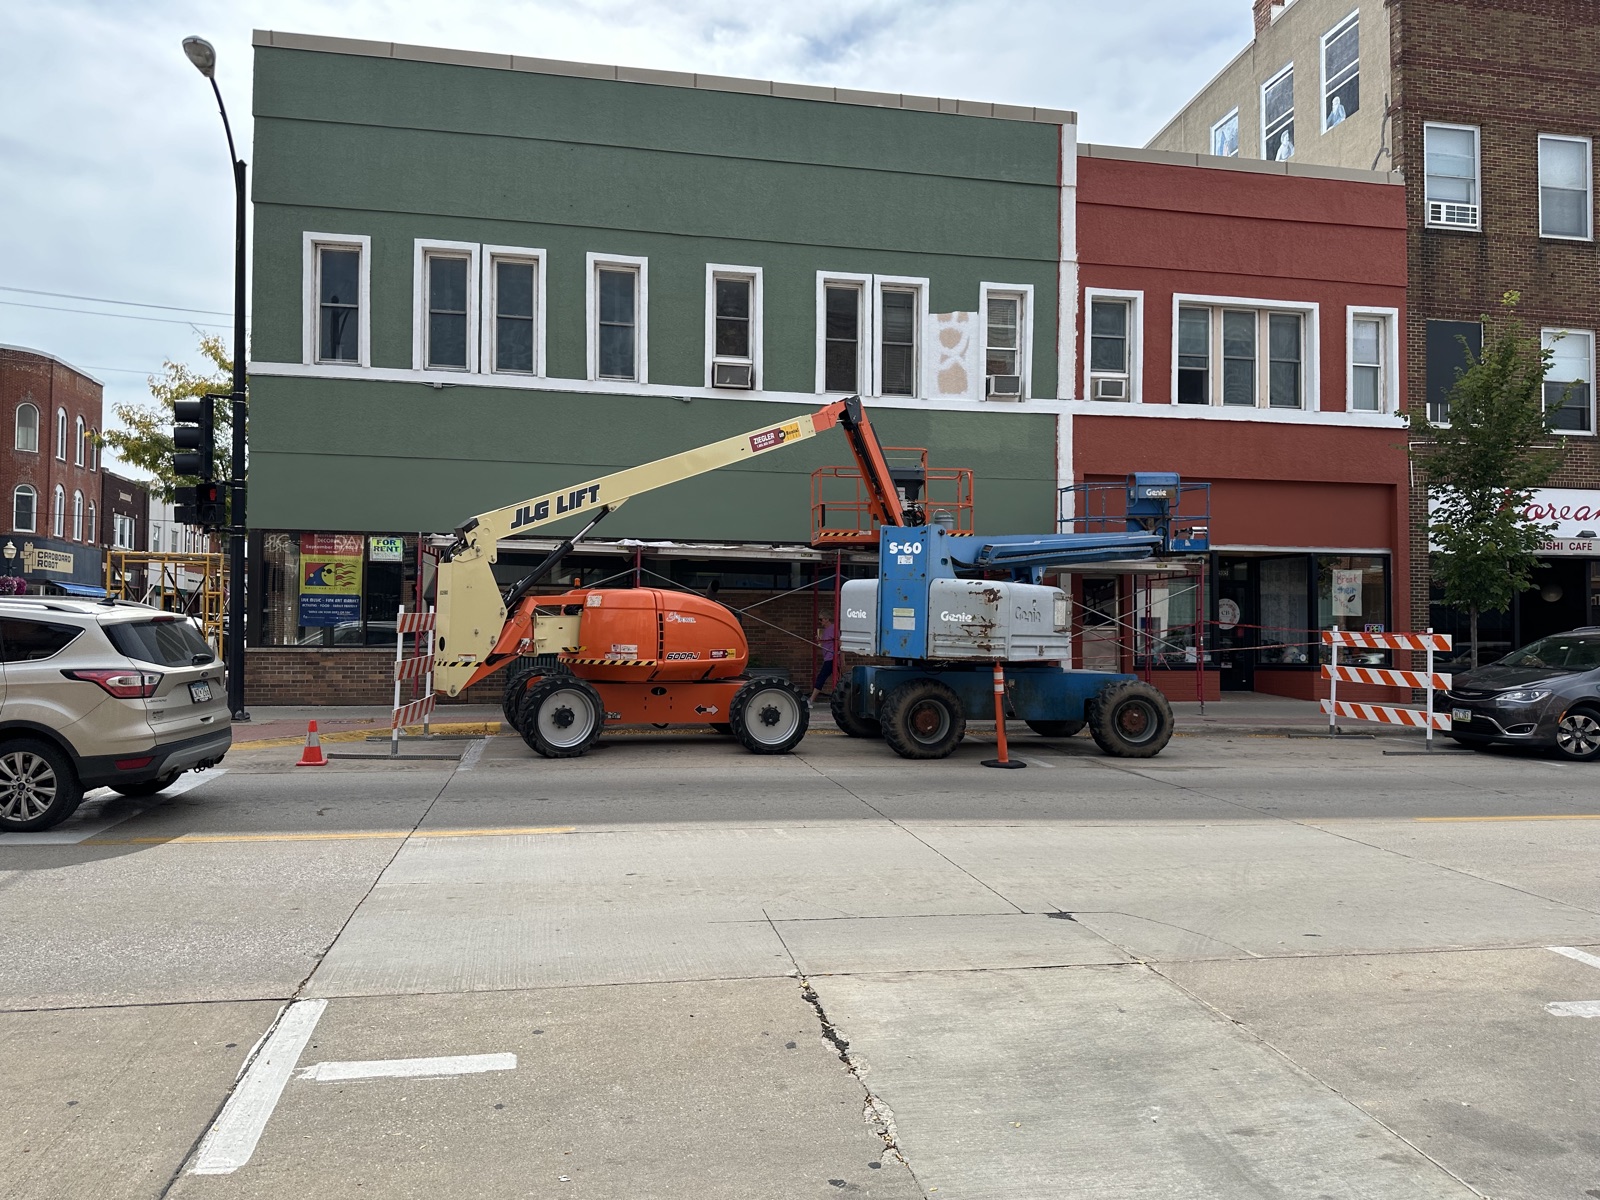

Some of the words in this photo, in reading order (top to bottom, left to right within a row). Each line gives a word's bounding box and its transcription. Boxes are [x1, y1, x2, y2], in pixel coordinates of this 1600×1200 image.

[753, 432, 775, 445] ZIEGLER
[1146, 488, 1167, 496] Genie
[510, 500, 549, 530] JLG
[557, 484, 600, 514] LIFT
[889, 542, 922, 554] S-60
[1569, 540, 1593, 551] CAFÉ
[37, 551, 71, 563] CARDBOARD
[37, 560, 58, 569] ROBOT
[846, 608, 867, 619] Genie
[940, 610, 973, 622] Genie
[1015, 606, 1041, 622] Genie
[666, 652, 700, 661] 600AJ
